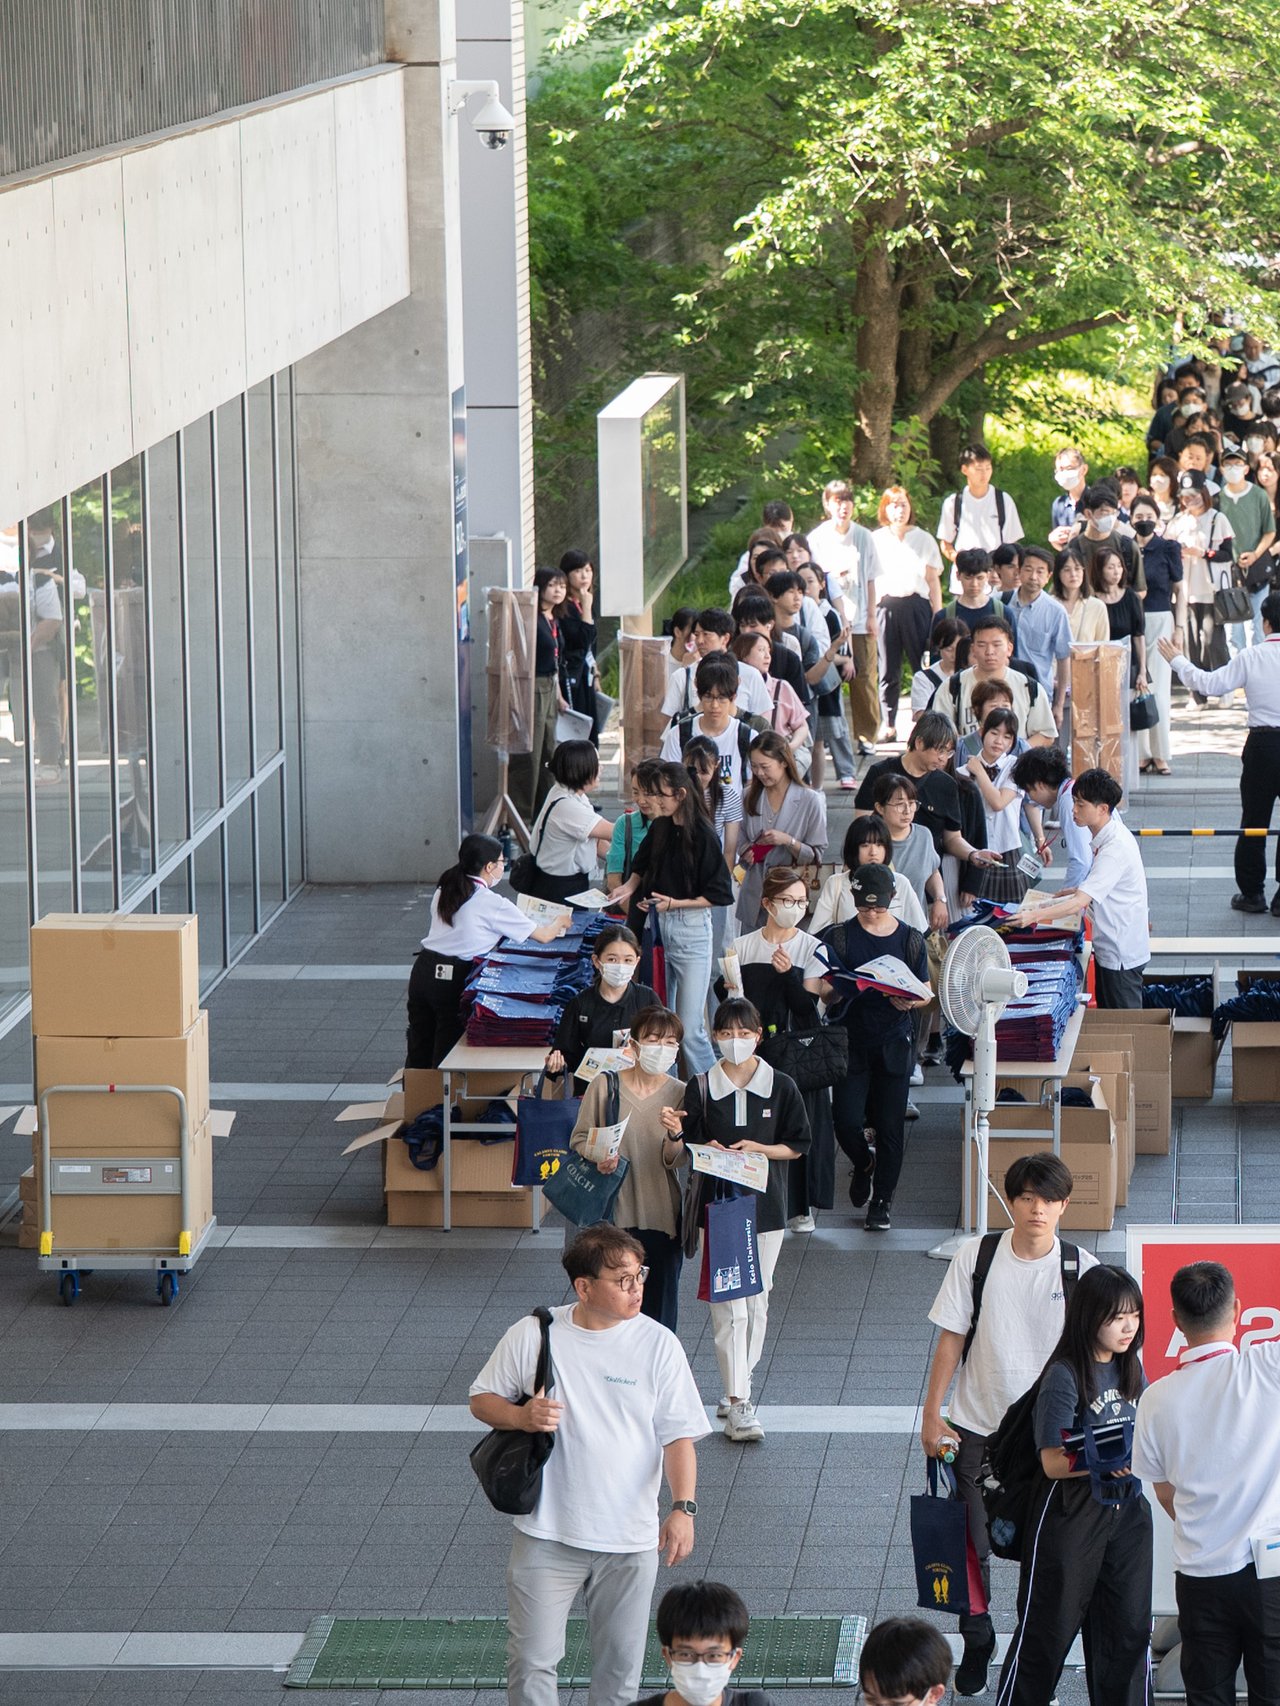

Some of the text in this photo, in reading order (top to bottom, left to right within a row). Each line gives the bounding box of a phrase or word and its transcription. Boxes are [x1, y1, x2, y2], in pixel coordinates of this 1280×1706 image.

[566, 1163, 596, 1193] COACH
[745, 1218, 757, 1285] Keio University
